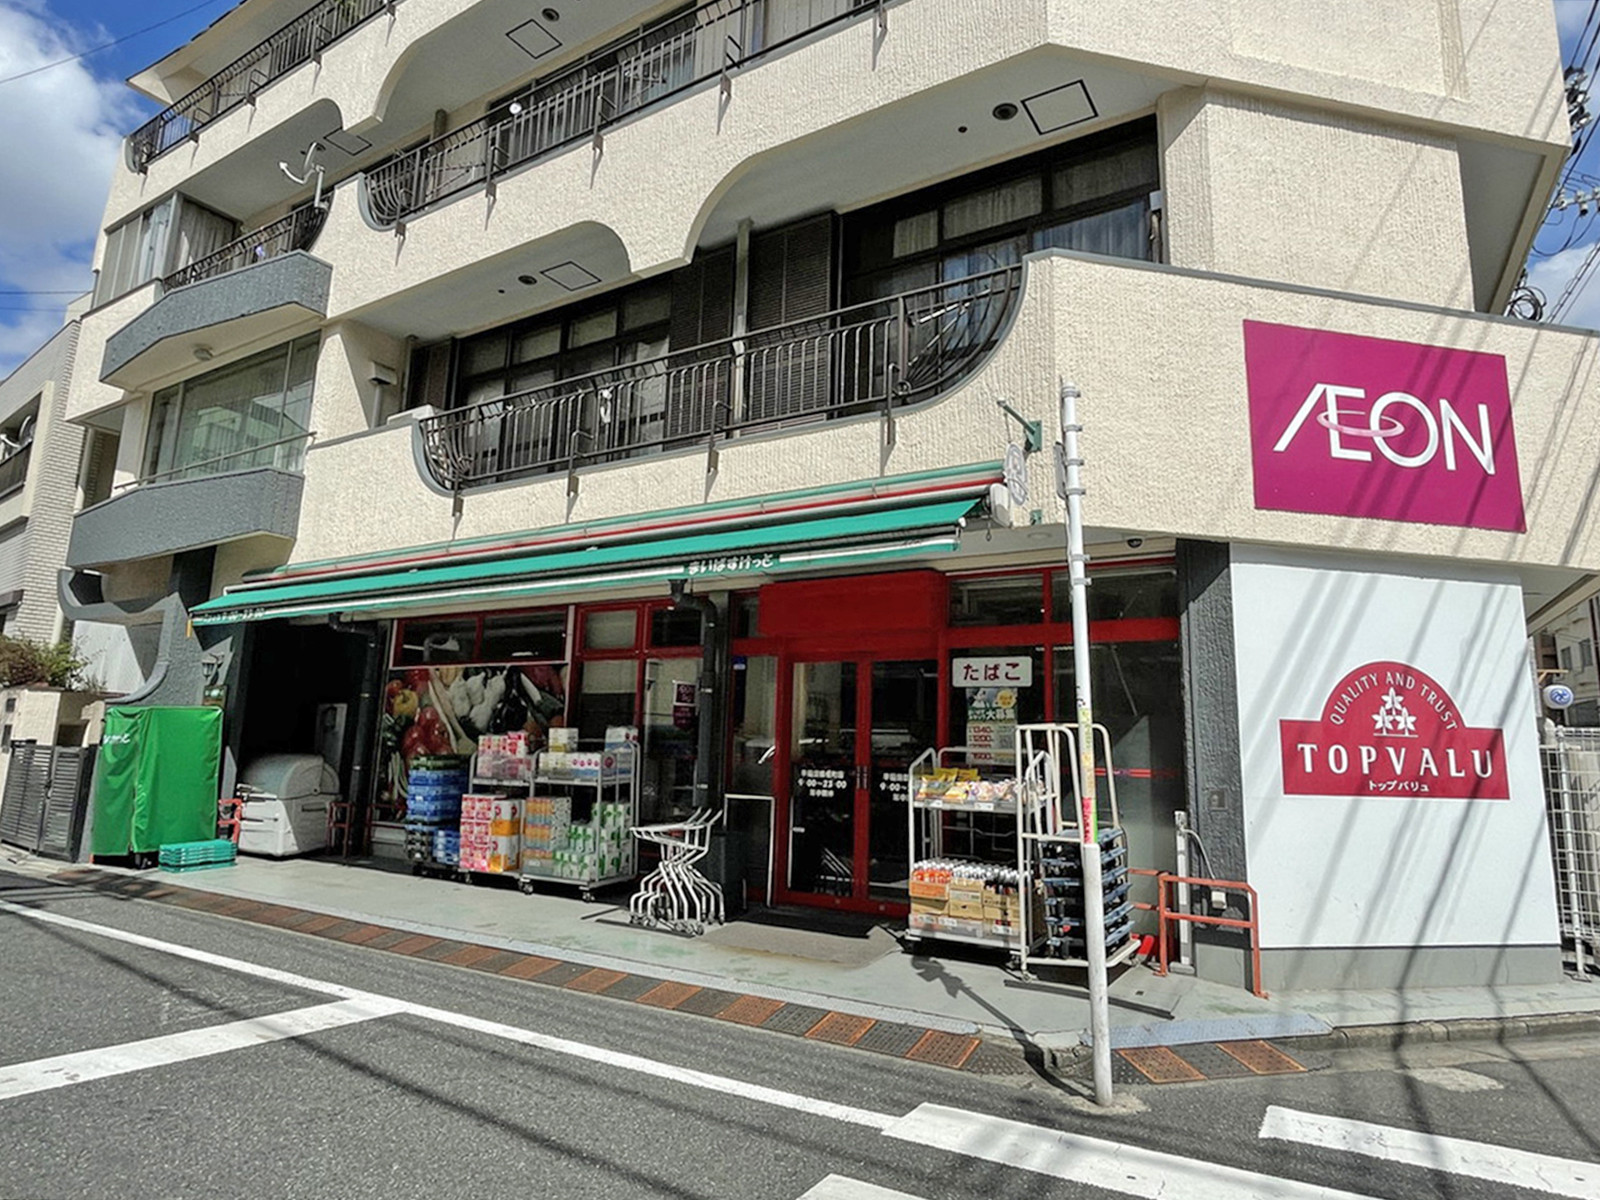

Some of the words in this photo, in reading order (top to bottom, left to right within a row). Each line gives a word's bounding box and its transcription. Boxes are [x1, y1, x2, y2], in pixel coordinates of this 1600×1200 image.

[688, 553, 774, 575] まいばすけっと
[963, 663, 1021, 681] たばこ
[1329, 672, 1379, 725] QUALITY
[1385, 671, 1415, 690] AND
[1420, 683, 1458, 730] TRUST
[1297, 743, 1493, 778] TOPVALU
[1368, 780, 1430, 792] トップバリュ
